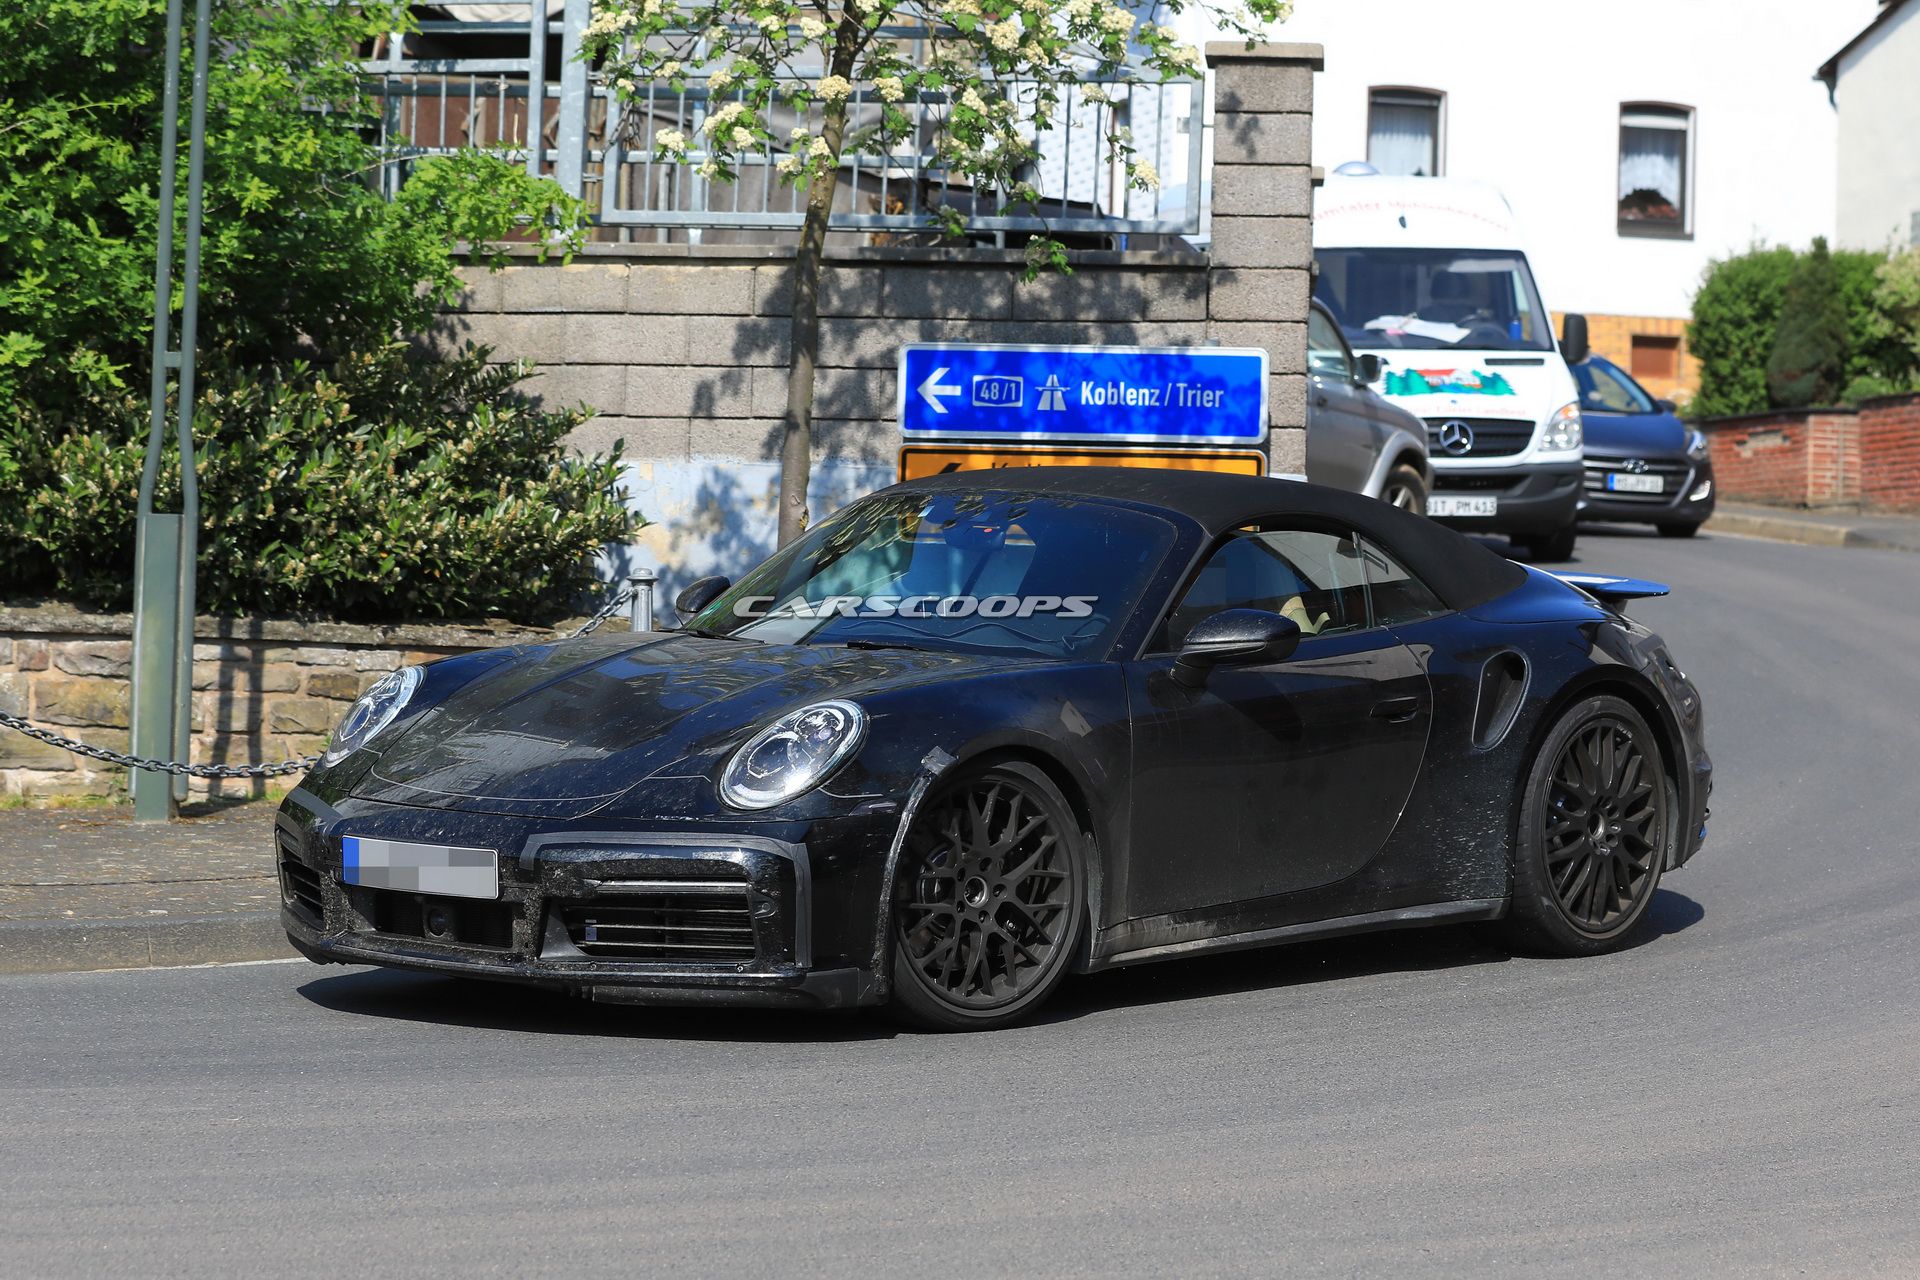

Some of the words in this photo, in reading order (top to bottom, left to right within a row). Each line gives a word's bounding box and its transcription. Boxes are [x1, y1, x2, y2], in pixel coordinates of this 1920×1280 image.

[979, 381, 1016, 401] 48/1
[1080, 381, 1160, 407] Koblenz
[1176, 384, 1224, 409] Trier
